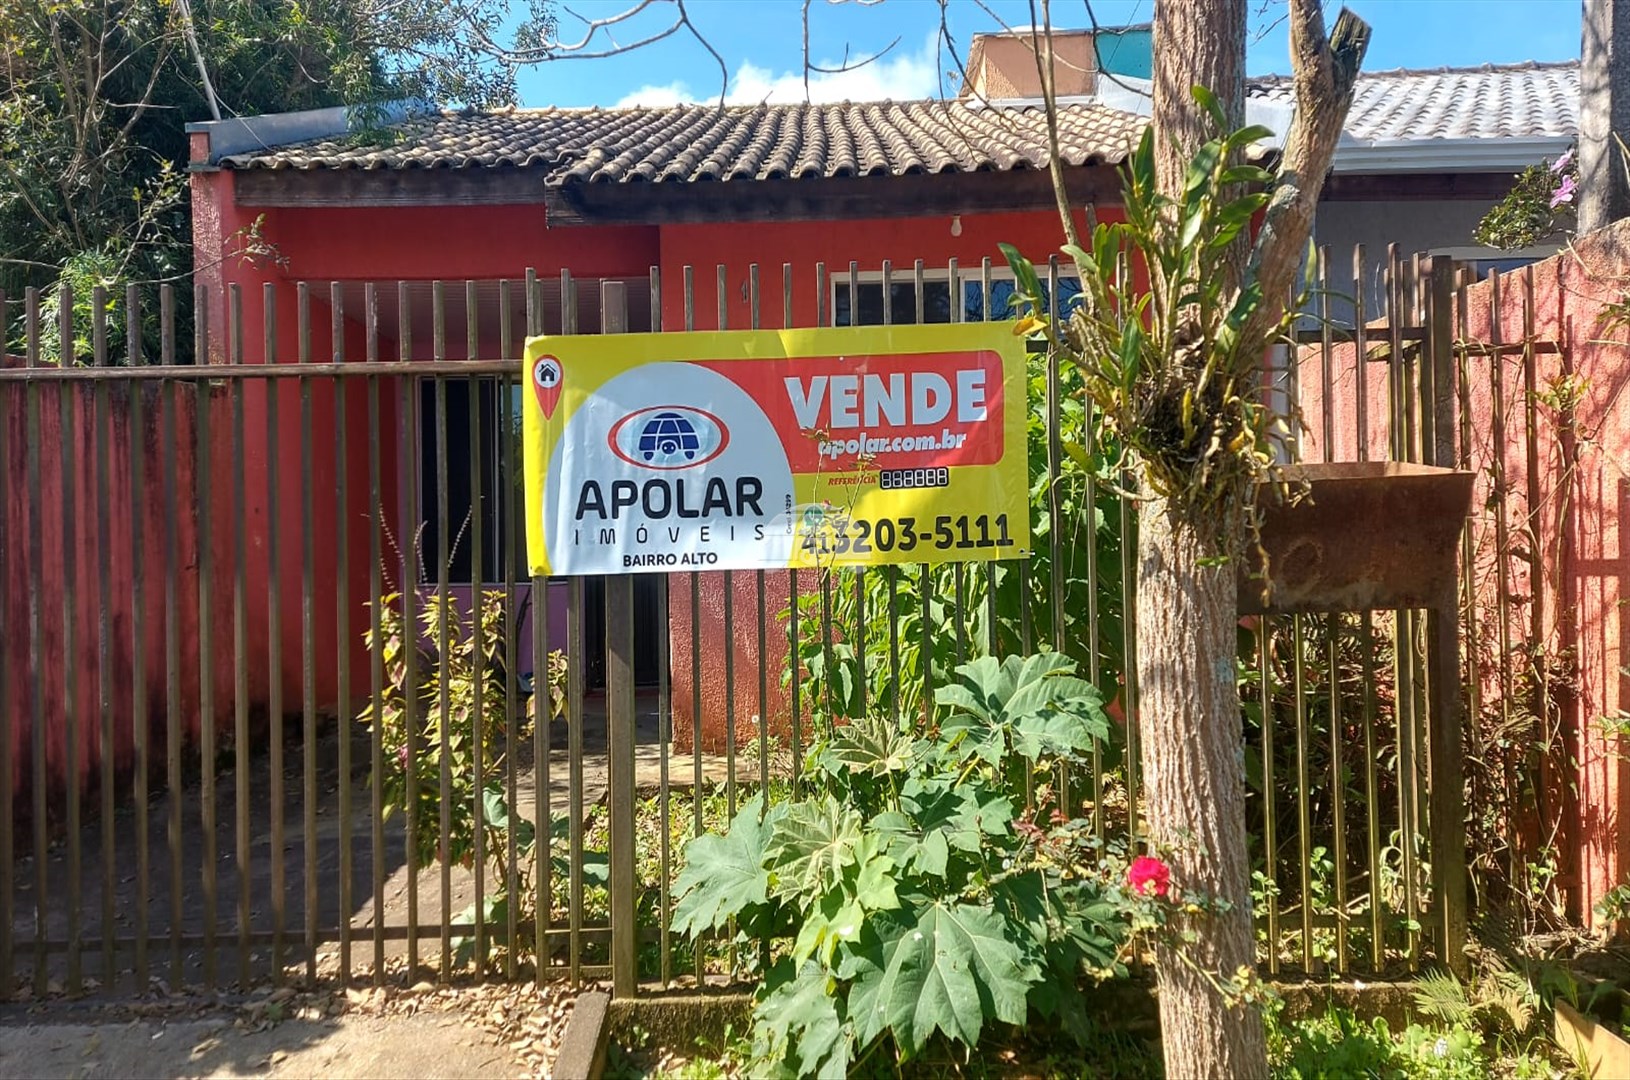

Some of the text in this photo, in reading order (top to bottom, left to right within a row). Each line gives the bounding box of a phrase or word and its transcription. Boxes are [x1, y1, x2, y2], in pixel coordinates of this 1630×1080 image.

[784, 369, 988, 429] VENDE
[817, 428, 967, 460] apolar.com.br
[575, 476, 764, 521] APOLAR
[574, 523, 765, 546] IMÓVEIS
[622, 552, 719, 567] BAIRRO ALTO
